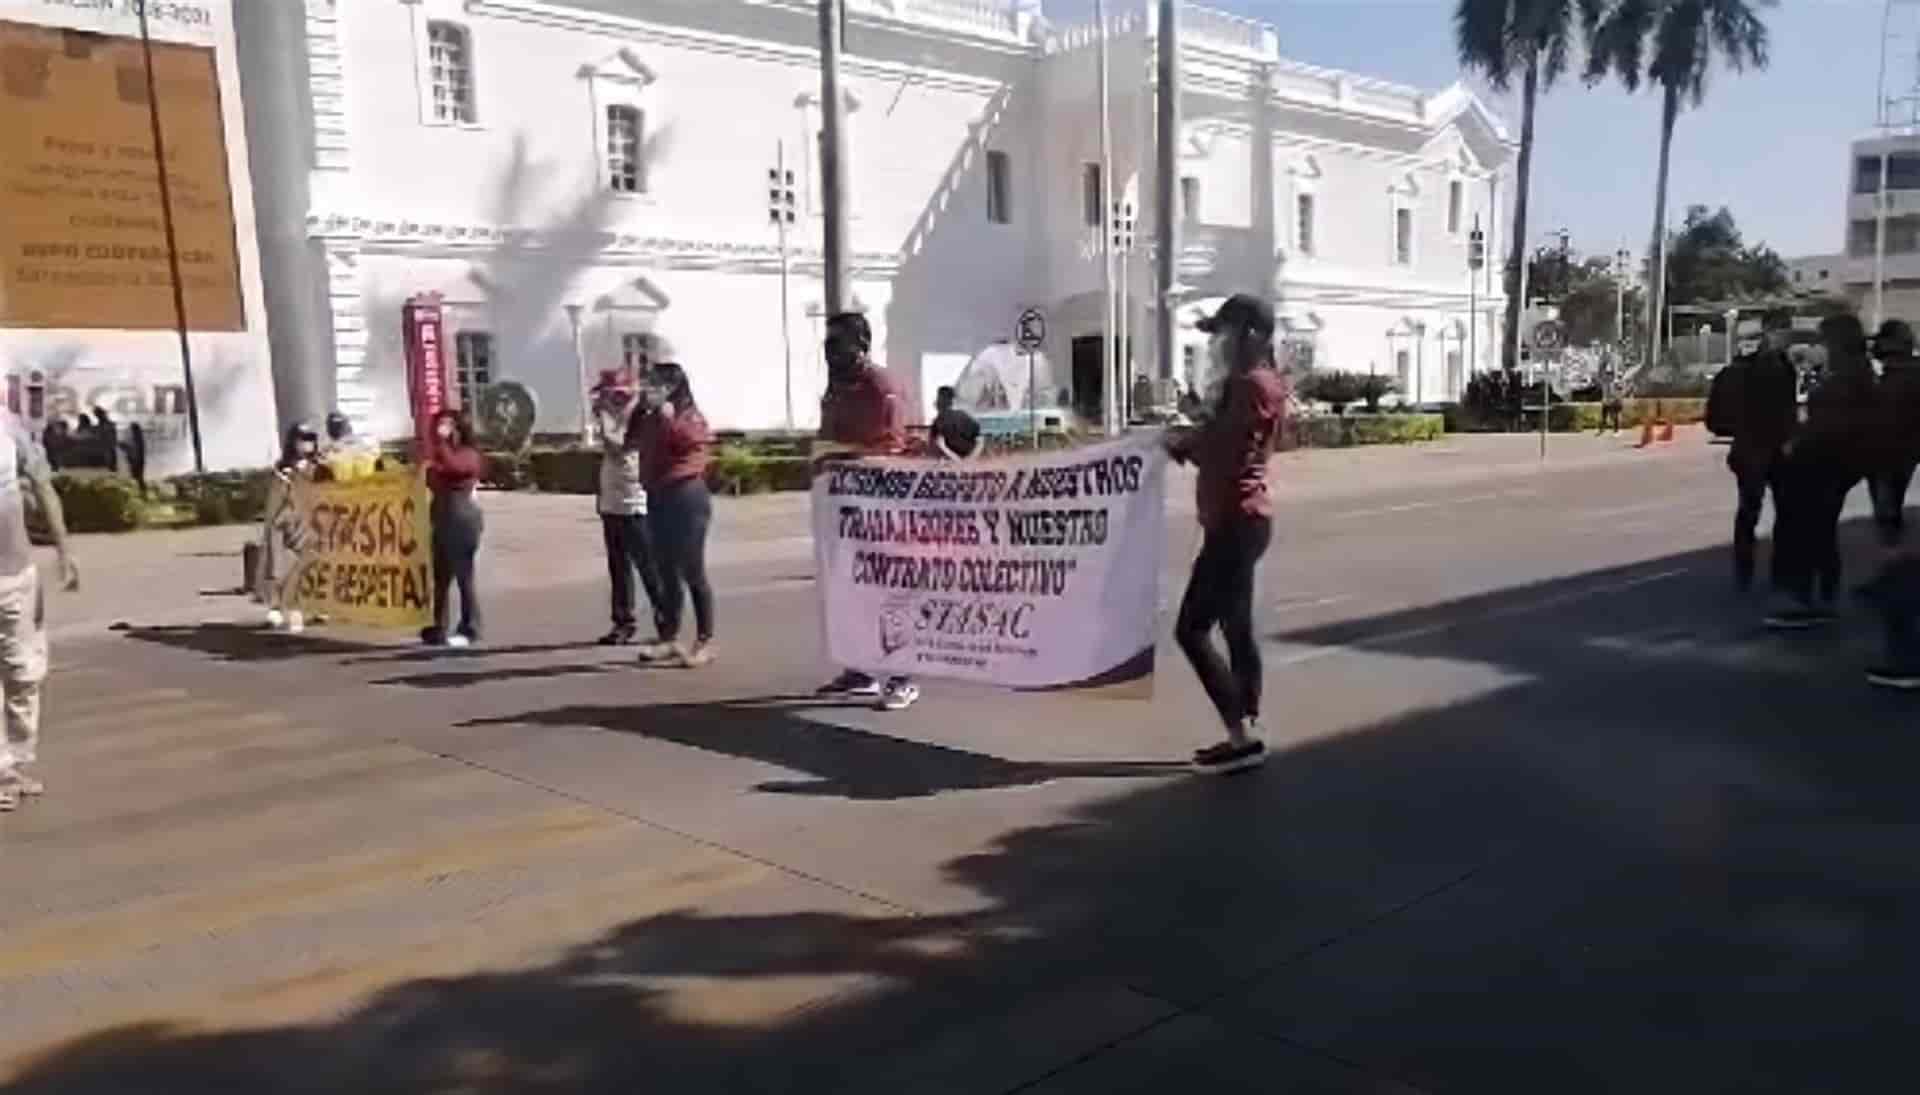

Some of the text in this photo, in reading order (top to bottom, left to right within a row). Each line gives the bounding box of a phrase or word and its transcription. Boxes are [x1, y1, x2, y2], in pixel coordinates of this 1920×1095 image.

[982, 508, 1001, 545] Y
[1006, 507, 1109, 547] NUESTRO
[854, 549, 956, 592] CONTRATO
[914, 599, 1036, 639] STASAC
